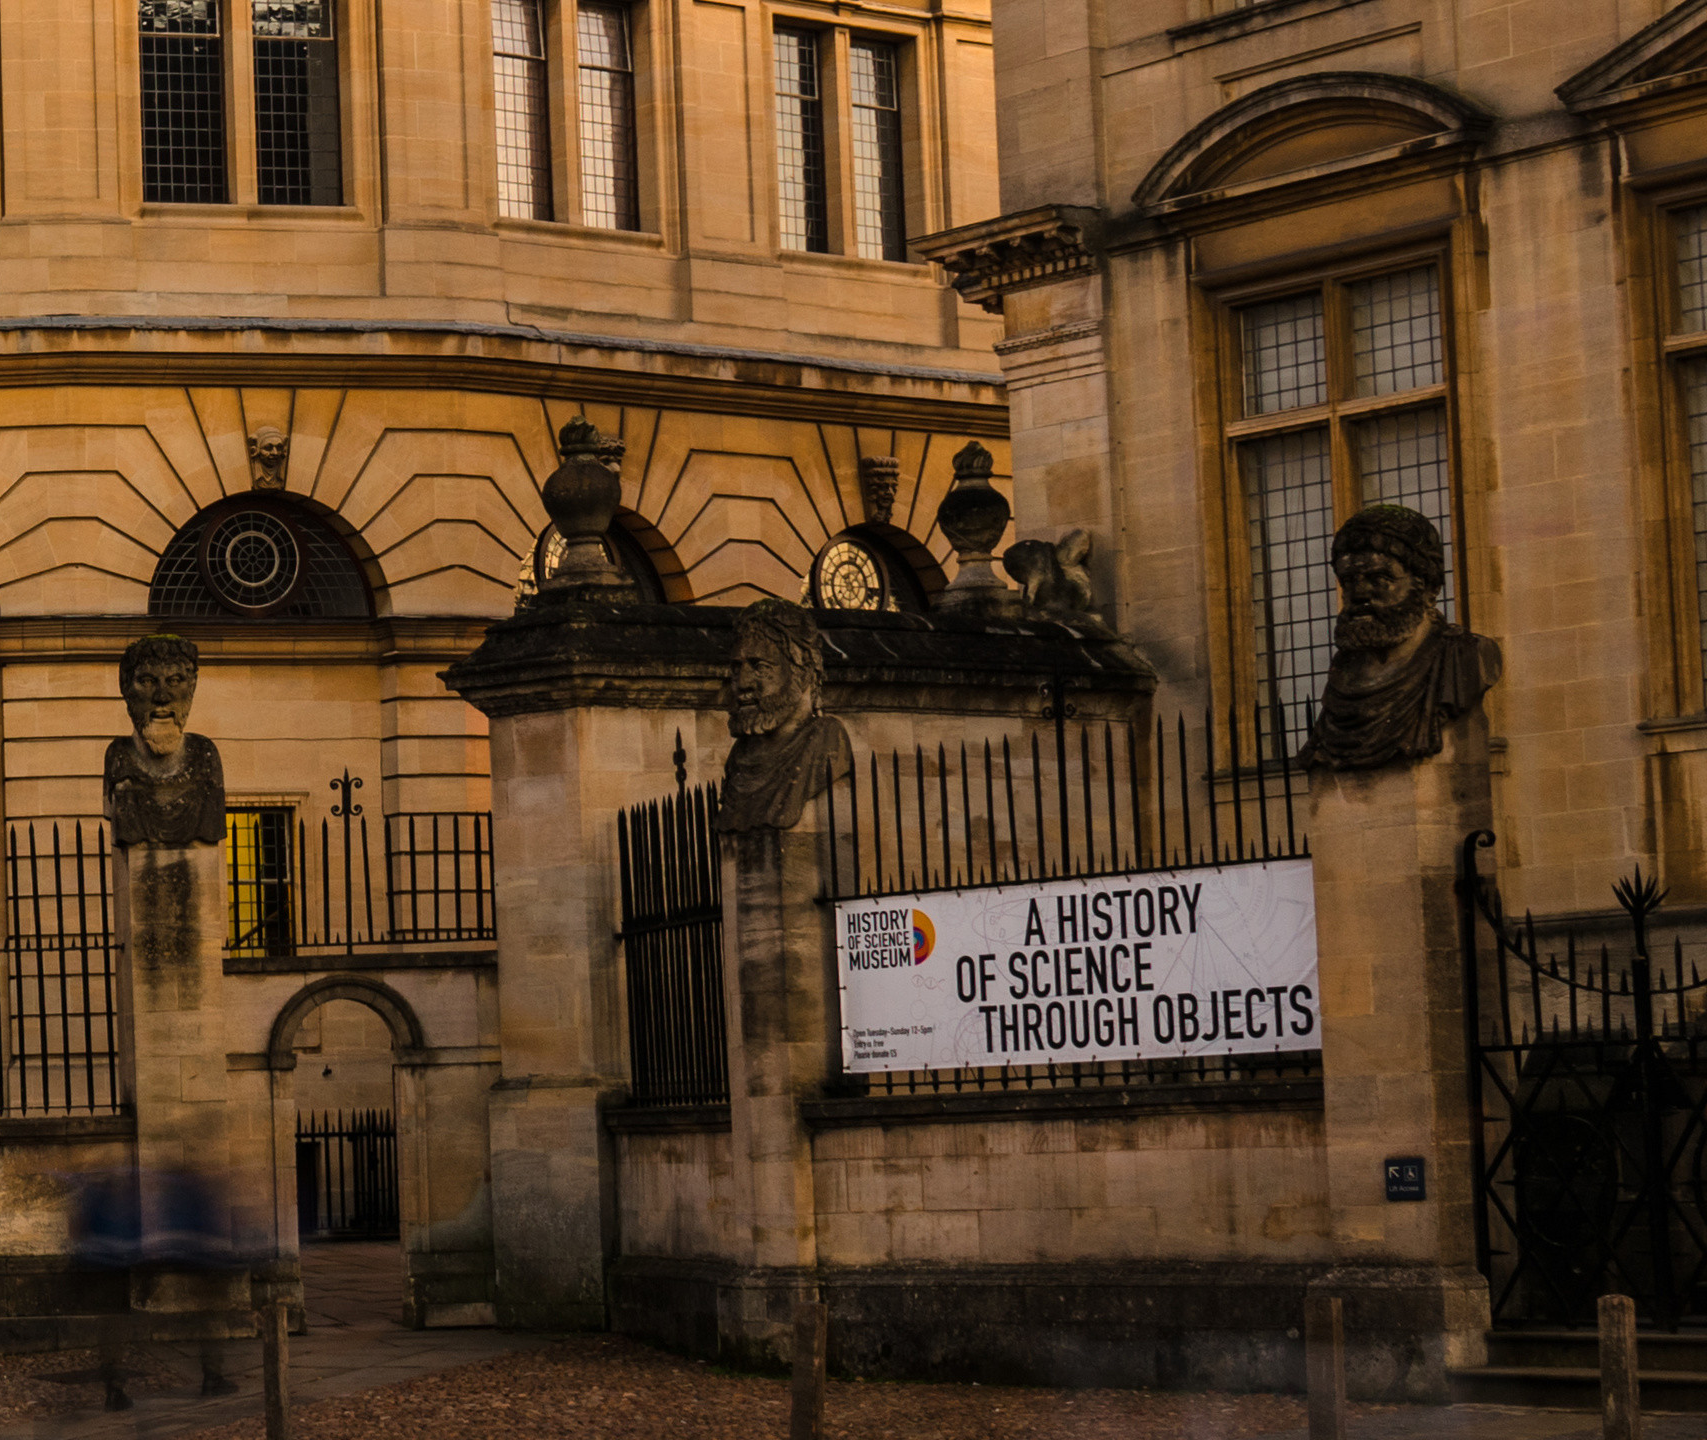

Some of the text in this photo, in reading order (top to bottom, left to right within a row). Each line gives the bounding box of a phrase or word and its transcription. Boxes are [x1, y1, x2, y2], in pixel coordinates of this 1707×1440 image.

[848, 909, 908, 934] HISTORY
[1024, 883, 1202, 946] A HISTORY
[848, 931, 910, 950] OF SCIENCE
[849, 947, 911, 971] MUSEUM
[956, 942, 1154, 1002] OF SCIENCE
[978, 985, 1314, 1053] THROUGH OBJECTS
